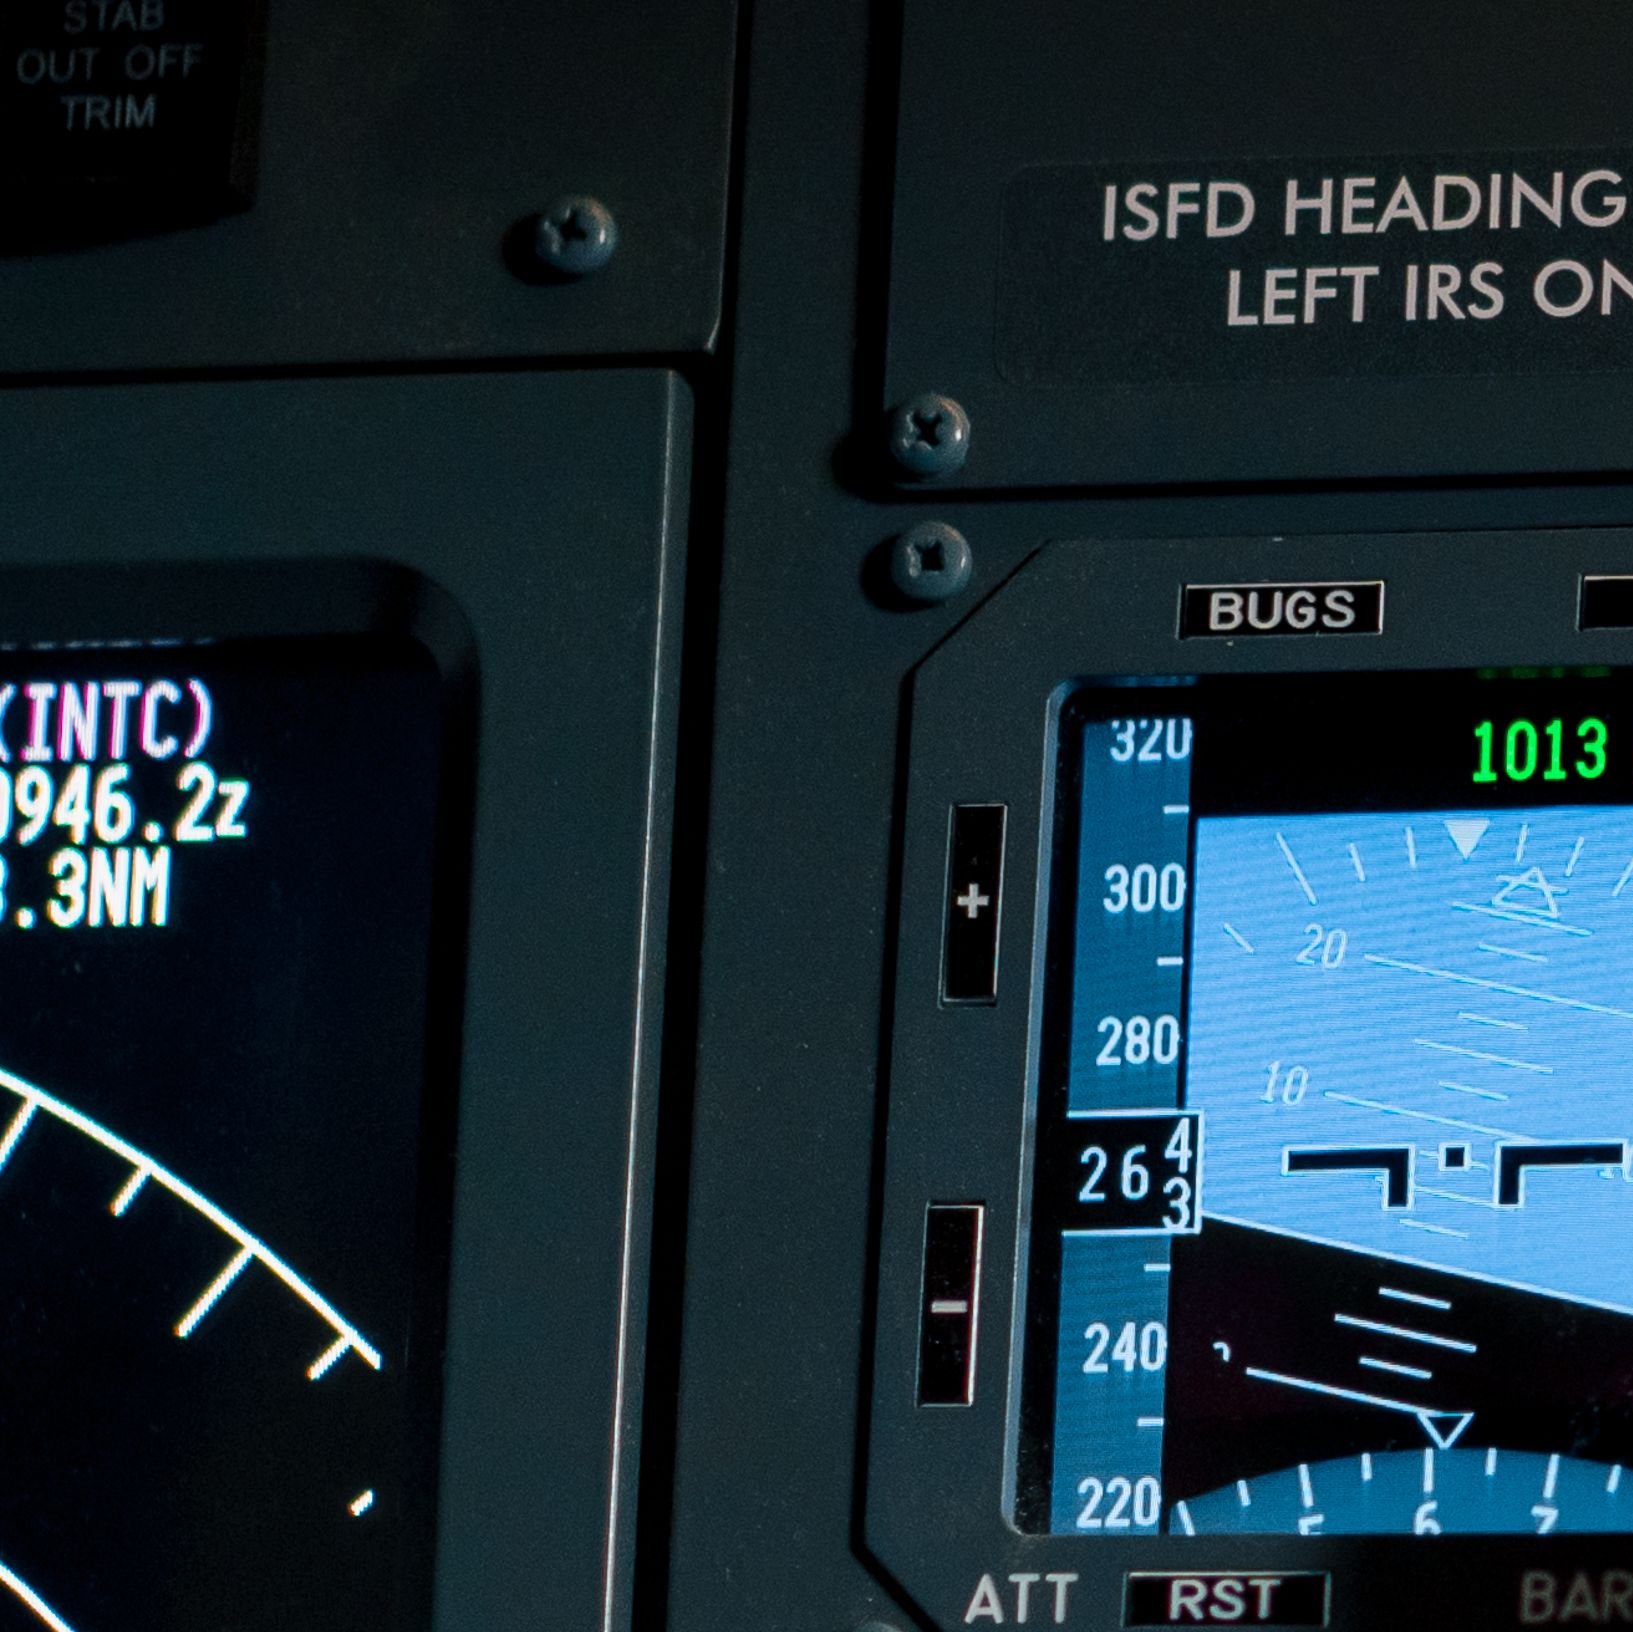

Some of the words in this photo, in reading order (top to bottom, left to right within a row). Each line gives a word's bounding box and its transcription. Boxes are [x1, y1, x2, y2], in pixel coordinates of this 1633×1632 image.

[64, 0, 165, 33] STAB
[16, 47, 98, 85] OUT
[125, 44, 201, 80] OFF
[62, 94, 156, 130] TRIM
[1103, 181, 1255, 241] ISFD
[1284, 169, 1627, 236] HEADING
[1227, 265, 1380, 326] LEFT
[1405, 261, 1505, 321] IRS
[1209, 589, 1355, 631] BUGS
[0, 678, 213, 763] (INTC)
[1109, 718, 1193, 766] 320
[1472, 717, 1608, 783] 1013
[1103, 862, 1187, 916] 300
[1297, 923, 1348, 969] 20
[1095, 1015, 1180, 1067] 280
[1260, 1061, 1309, 1105] 10
[1082, 1321, 1168, 1374] 240
[1076, 1476, 1162, 1530] 220
[964, 1572, 1079, 1624] ATT
[1168, 1578, 1282, 1620] RST
